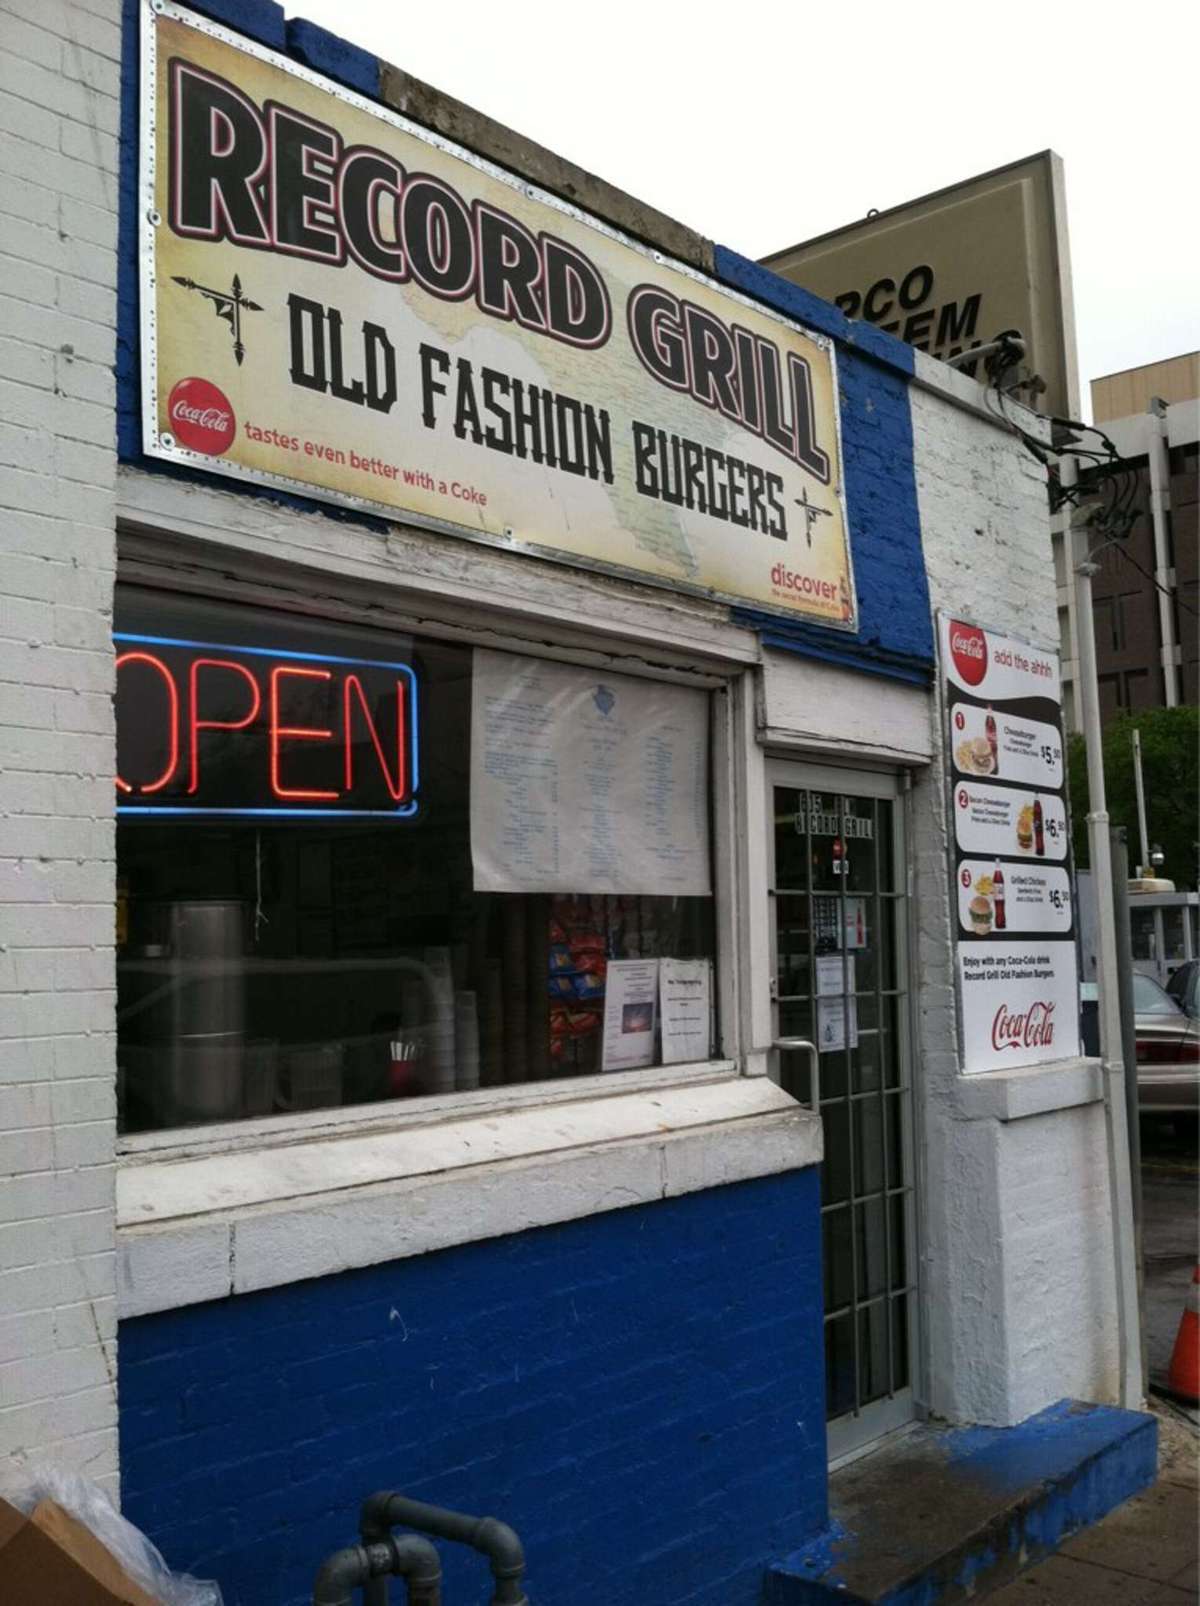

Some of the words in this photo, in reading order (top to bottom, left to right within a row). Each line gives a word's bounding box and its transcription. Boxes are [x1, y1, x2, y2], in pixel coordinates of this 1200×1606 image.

[168, 57, 612, 350] RECORD
[626, 283, 830, 485] GRILL
[288, 293, 398, 414] OLD
[418, 342, 615, 485] FASHION
[631, 420, 789, 541] BURGERS
[243, 421, 300, 452] tastes
[304, 442, 346, 466] even
[350, 451, 400, 481] better
[402, 470, 436, 492] with
[438, 480, 449, 495] a
[451, 480, 488, 506] Coke
[771, 563, 837, 600] discover
[993, 649, 1012, 667] add
[1014, 654, 1029, 672] the
[115, 652, 405, 801] OPEN
[963, 956, 979, 968] Enjoy
[991, 1001, 1056, 1051] Coca-Cola
